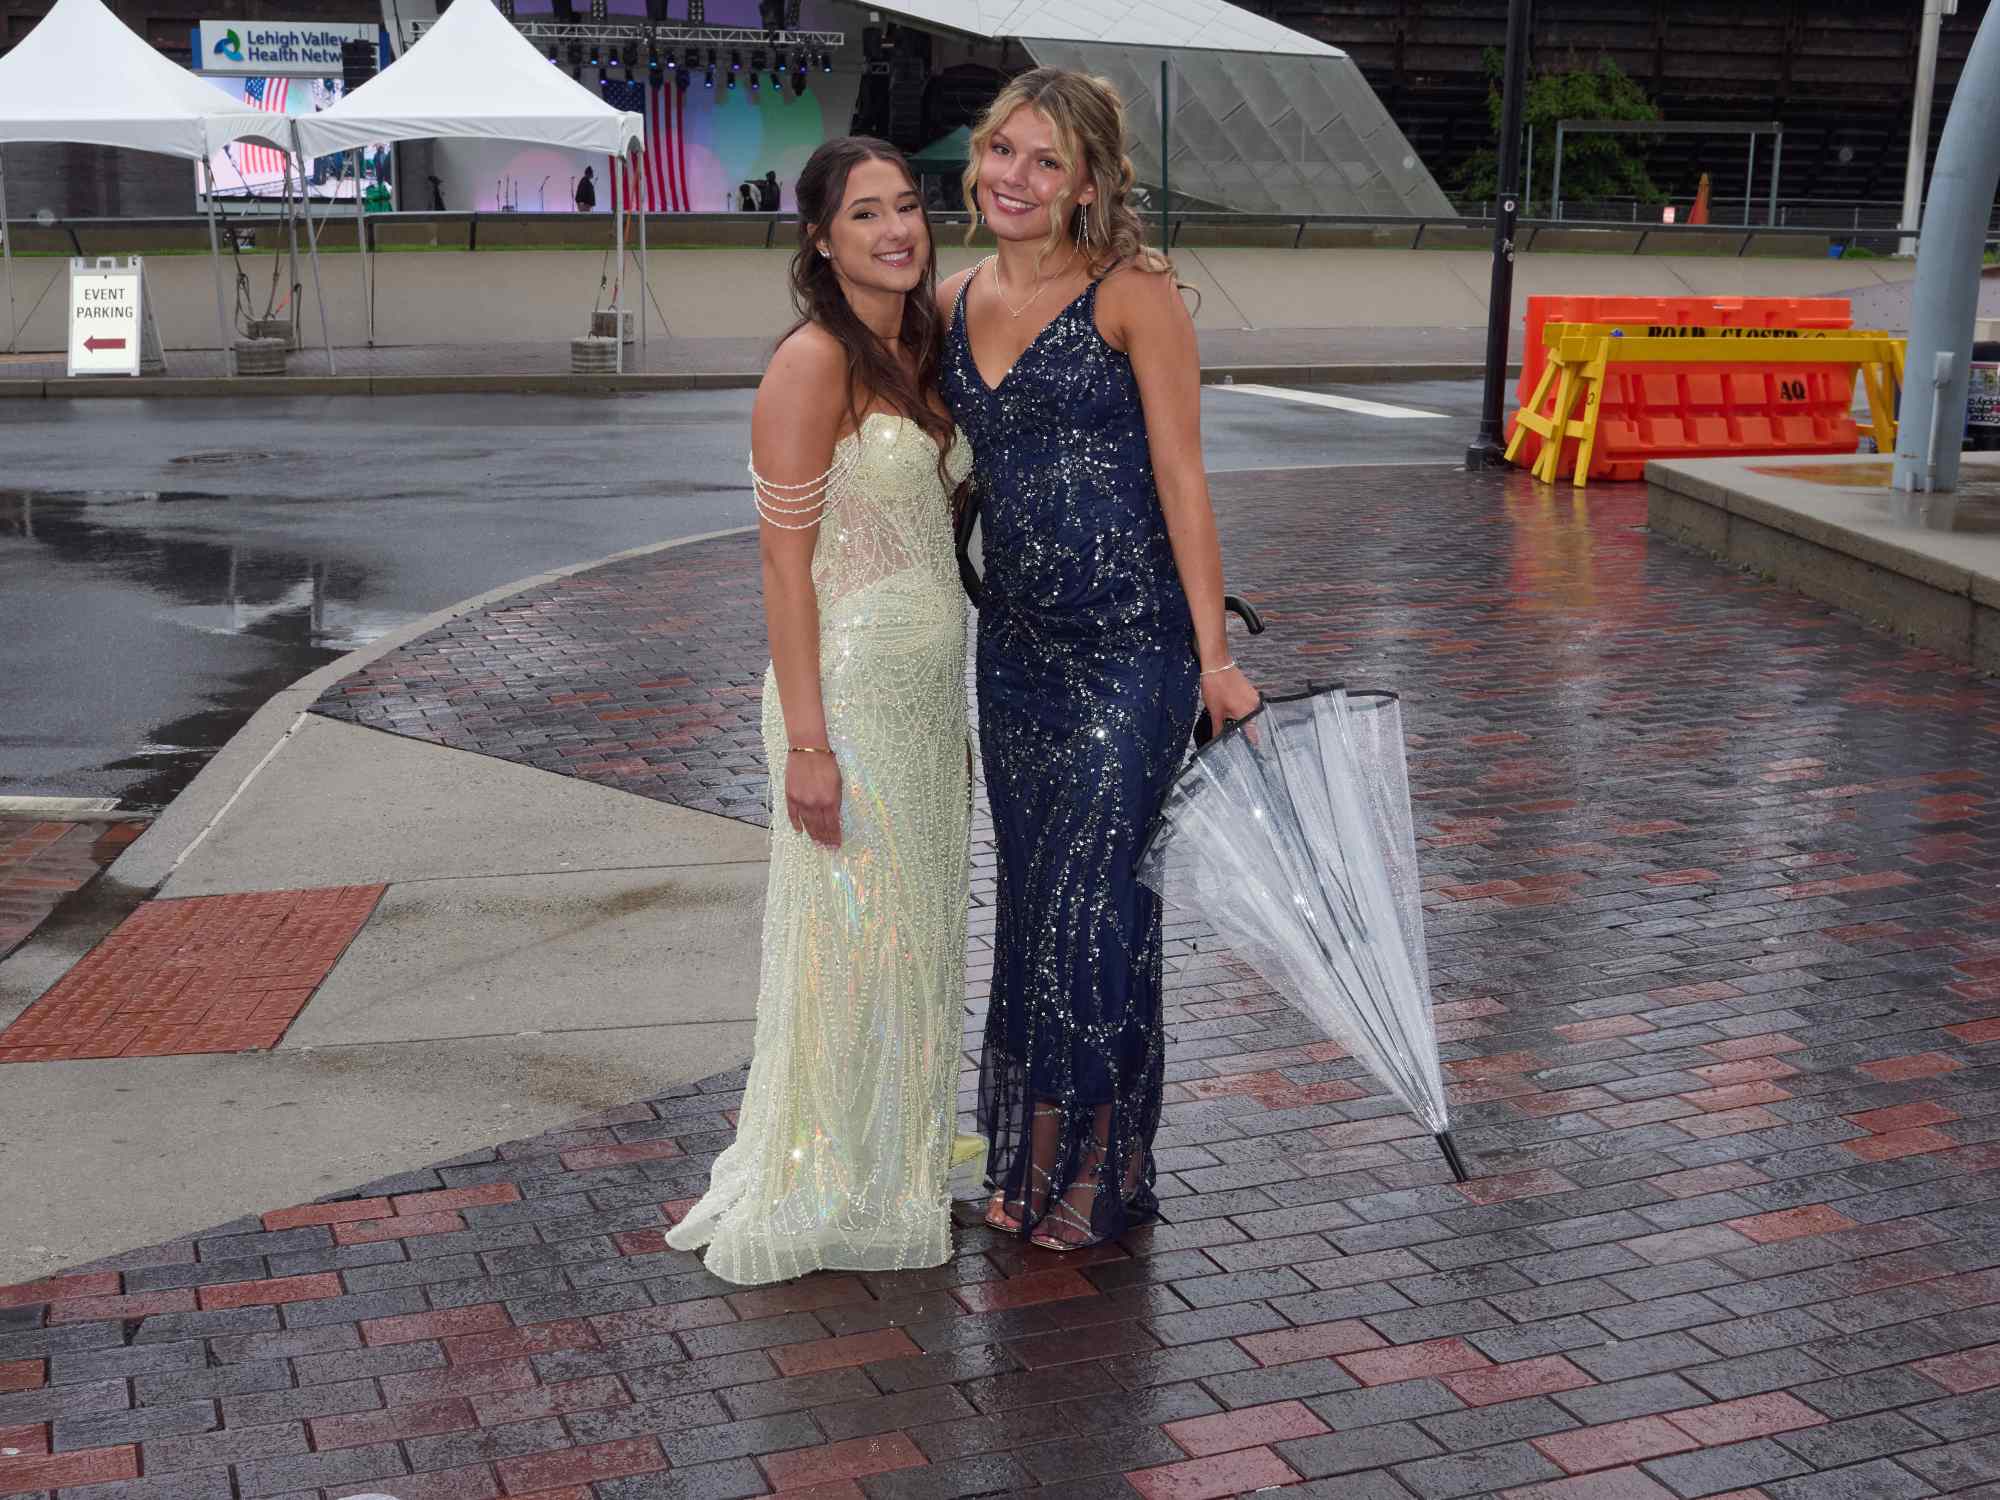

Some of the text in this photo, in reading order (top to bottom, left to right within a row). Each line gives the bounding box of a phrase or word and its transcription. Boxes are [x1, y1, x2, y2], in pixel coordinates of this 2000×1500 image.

[247, 30, 348, 48] Lehigh Valley
[248, 48, 343, 63] Health Netw
[84, 288, 125, 301] EVENT
[76, 306, 134, 319] PARKING
